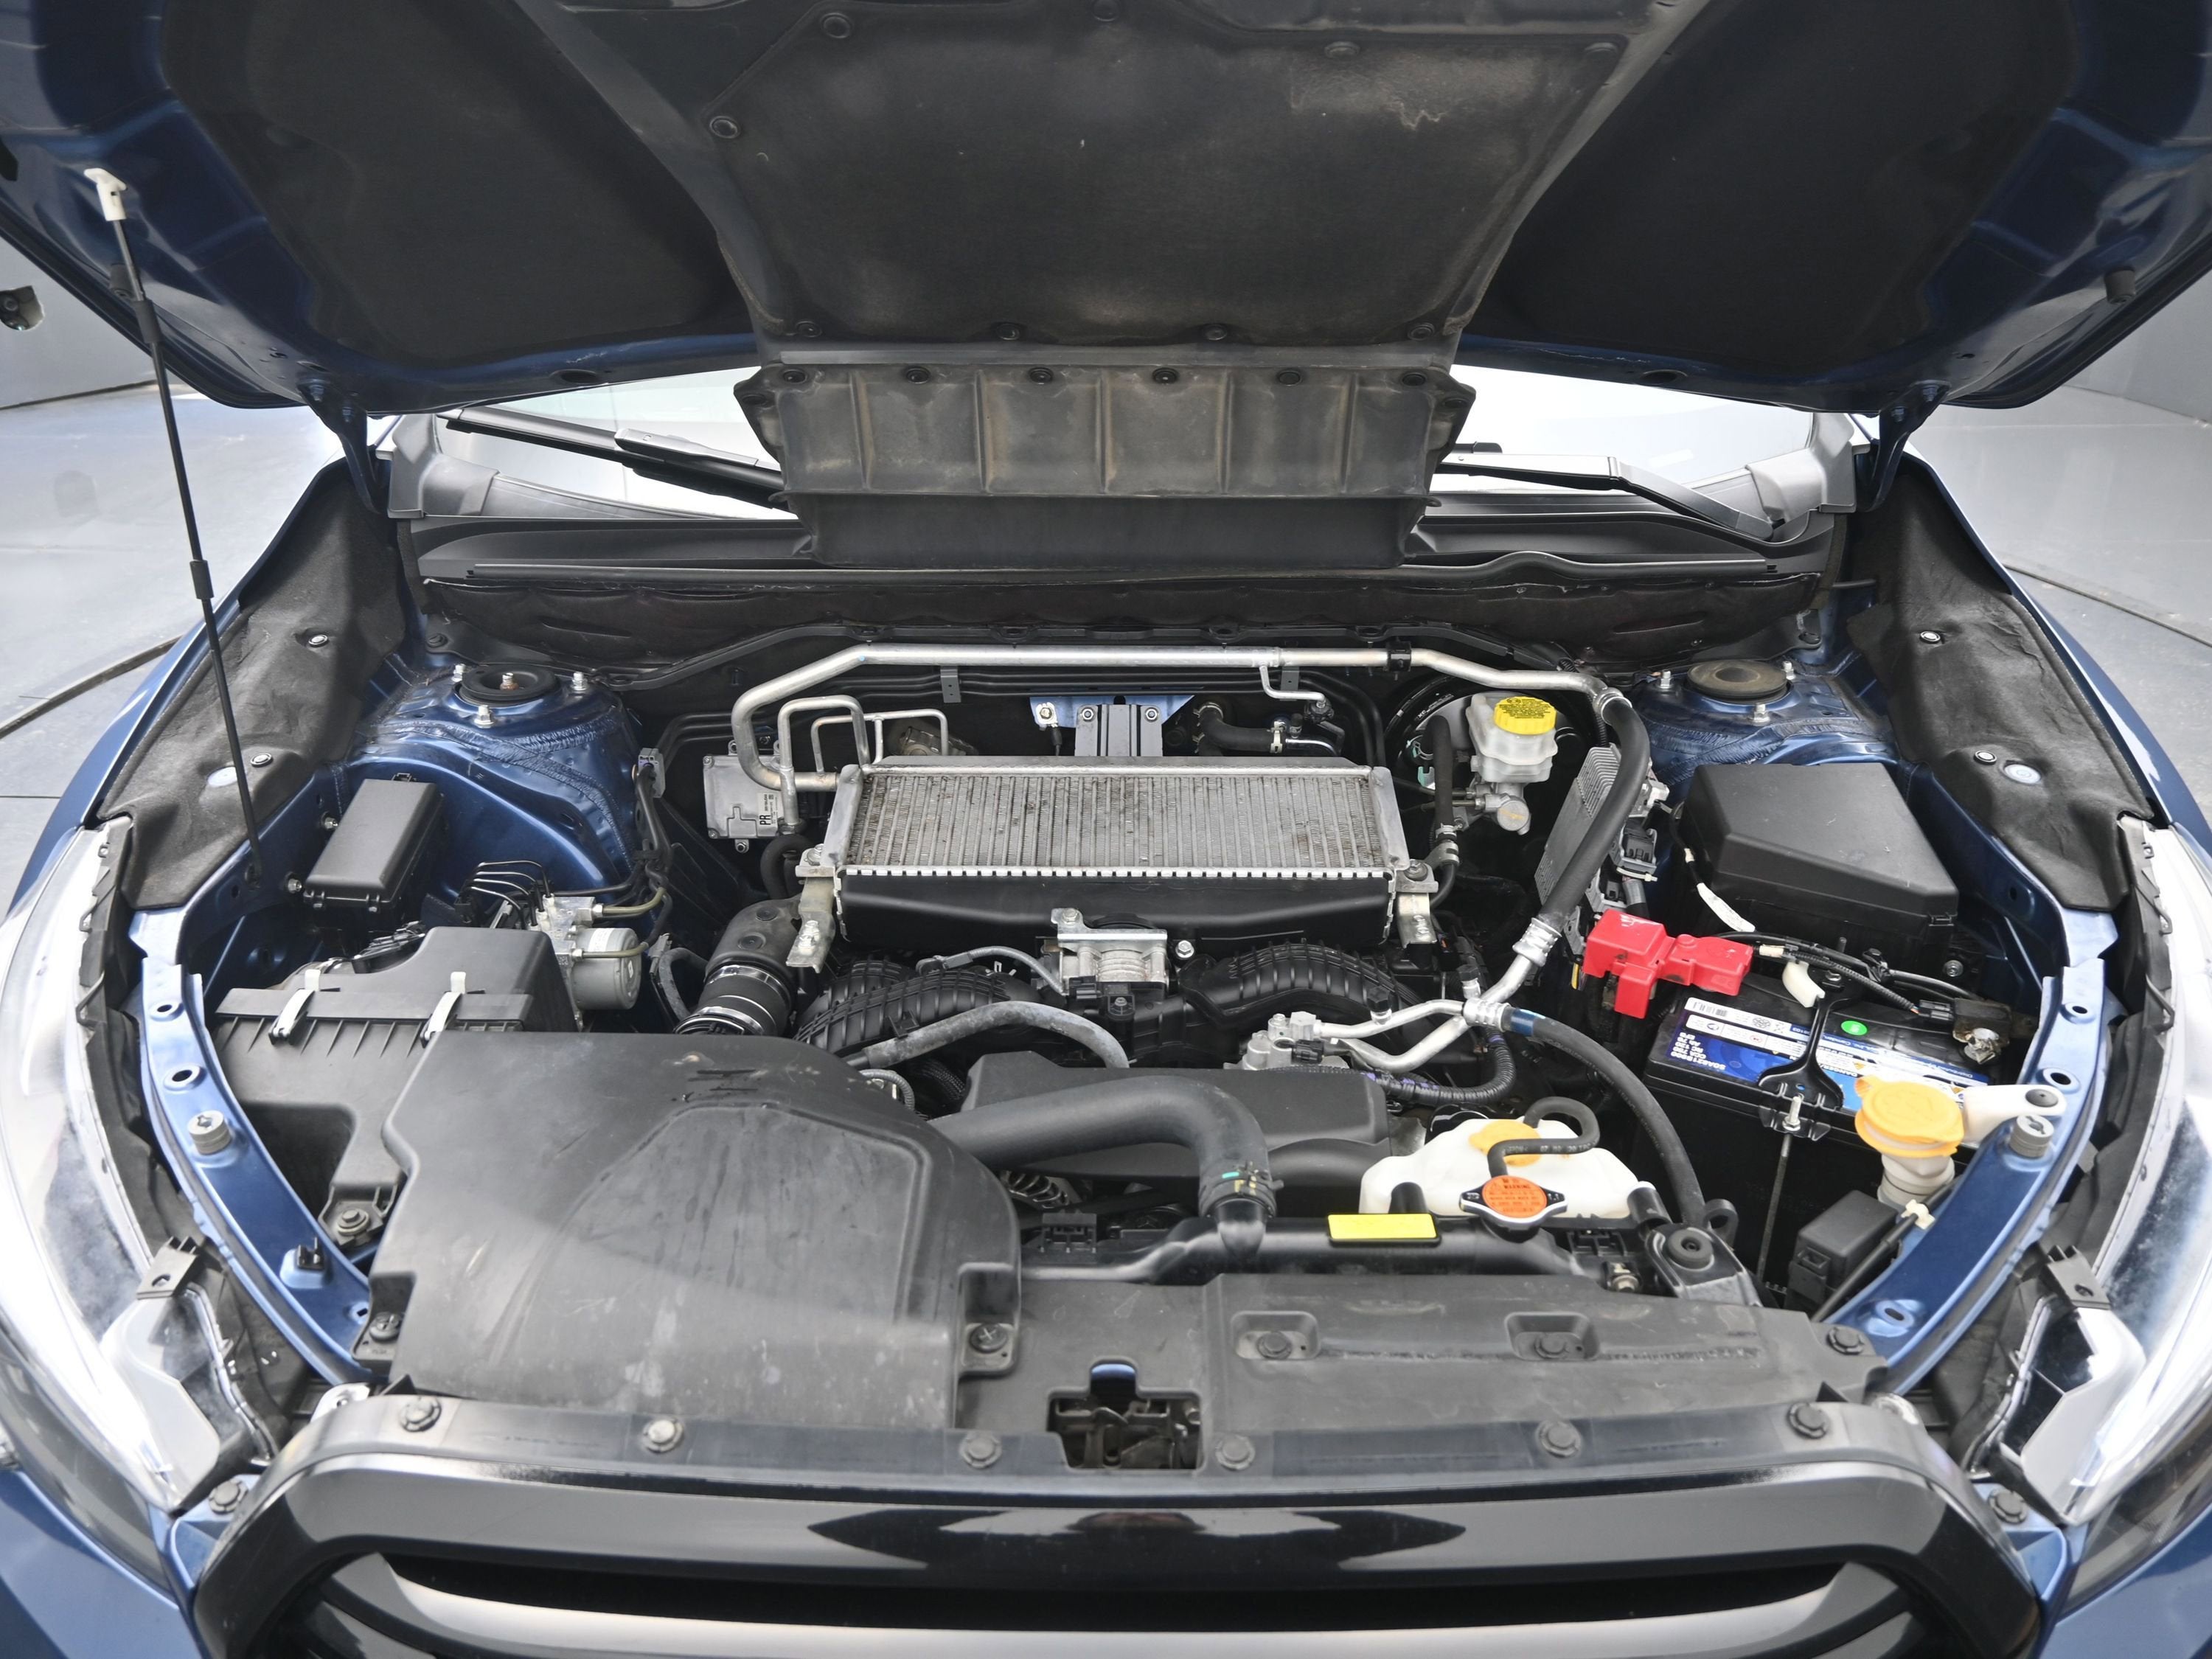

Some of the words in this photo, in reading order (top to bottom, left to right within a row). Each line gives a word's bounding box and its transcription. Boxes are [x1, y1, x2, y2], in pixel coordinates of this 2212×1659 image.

[759, 815, 771, 825] PR
[1674, 1041, 1690, 1049] 120
[1689, 1051, 1706, 1060] CCA
